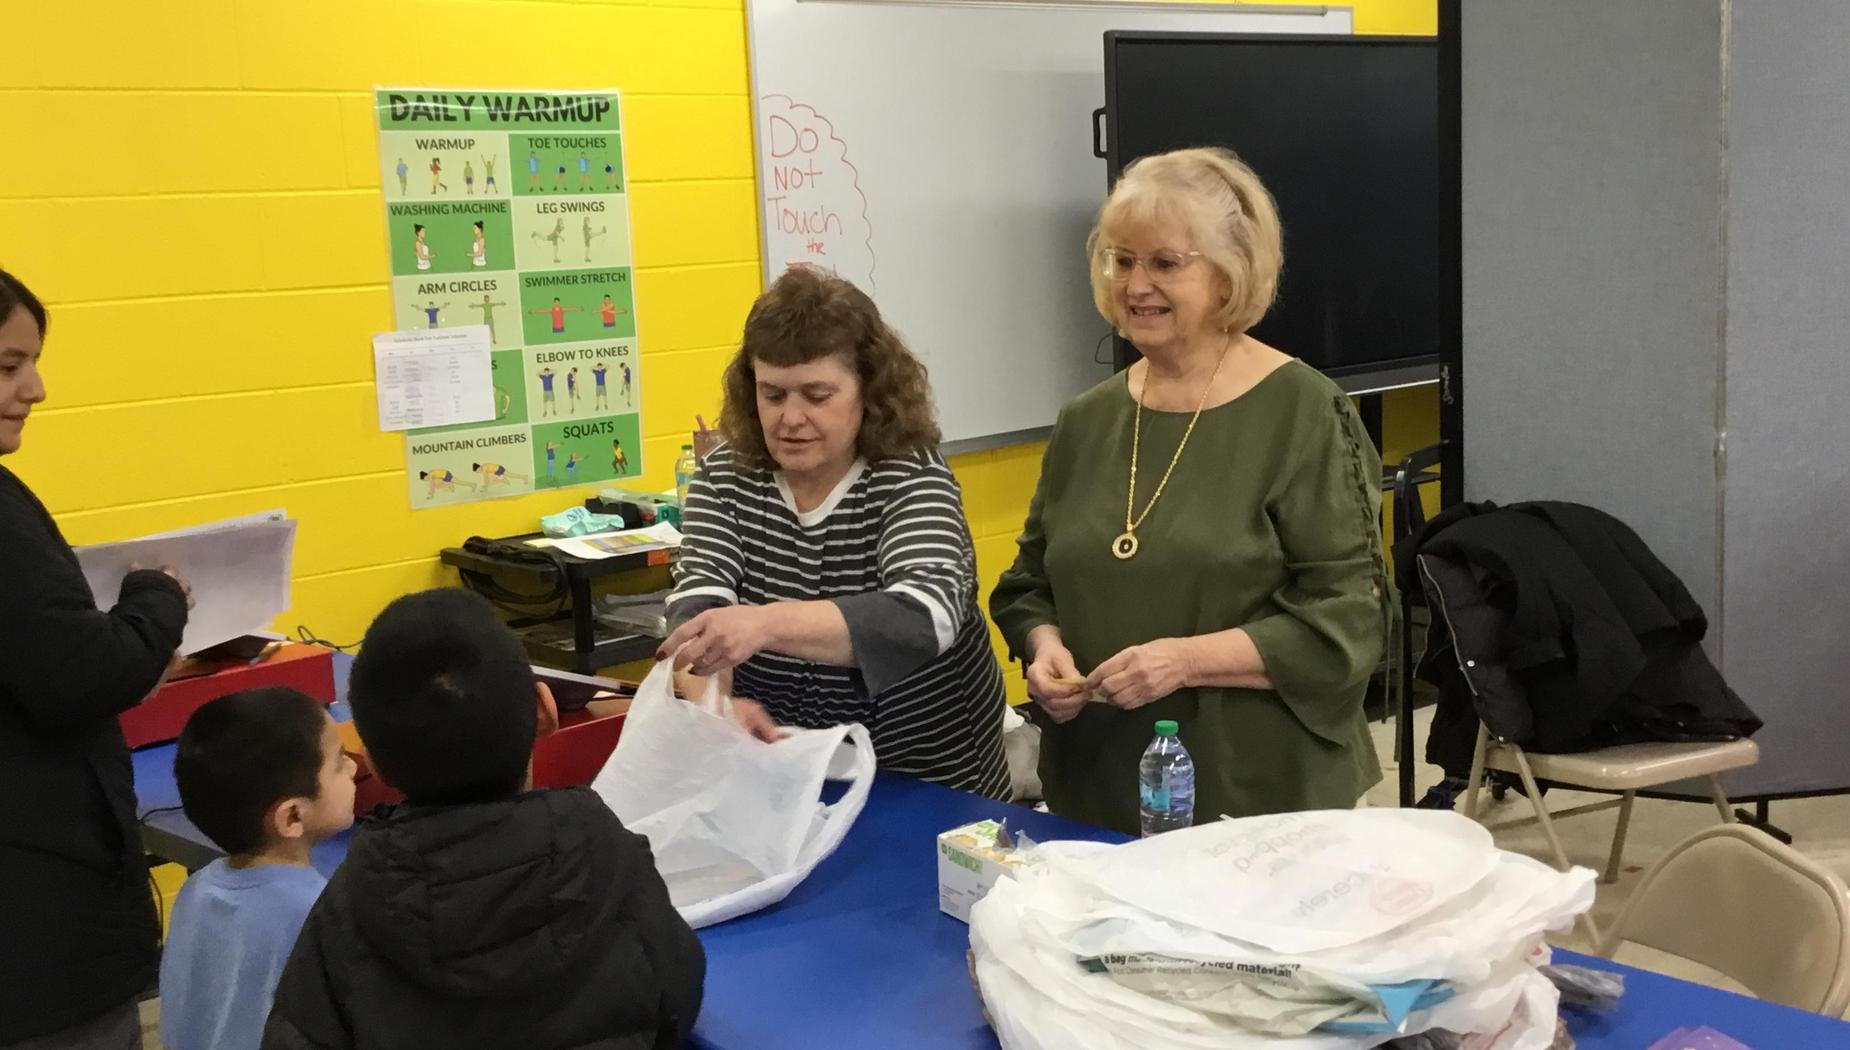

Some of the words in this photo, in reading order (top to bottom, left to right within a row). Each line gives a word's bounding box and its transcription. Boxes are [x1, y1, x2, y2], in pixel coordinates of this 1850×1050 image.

[389, 94, 475, 122] DAILY
[483, 95, 610, 123] WARMUP
[528, 137, 551, 149] TOE
[554, 137, 607, 149] TOUCHES
[769, 114, 818, 158] Do
[416, 138, 476, 151] WARMUP
[390, 204, 450, 217] WASHING
[452, 202, 507, 214] MACHINE
[536, 202, 558, 214] LEG
[560, 201, 605, 213] SWINGS
[767, 195, 842, 235] Touch
[418, 282, 447, 296] ARM
[450, 280, 498, 294] CIRCLES
[525, 275, 578, 288] SWIMMER
[580, 272, 626, 285] STRETCH
[536, 350, 576, 364] ELBOW
[577, 349, 594, 361] TO
[596, 346, 629, 358] KNEES
[562, 421, 614, 440] SQUATS
[412, 438, 474, 456] MOUNTAIN
[476, 433, 528, 448] CLIMBERS
[1110, 953, 1127, 965] bag
